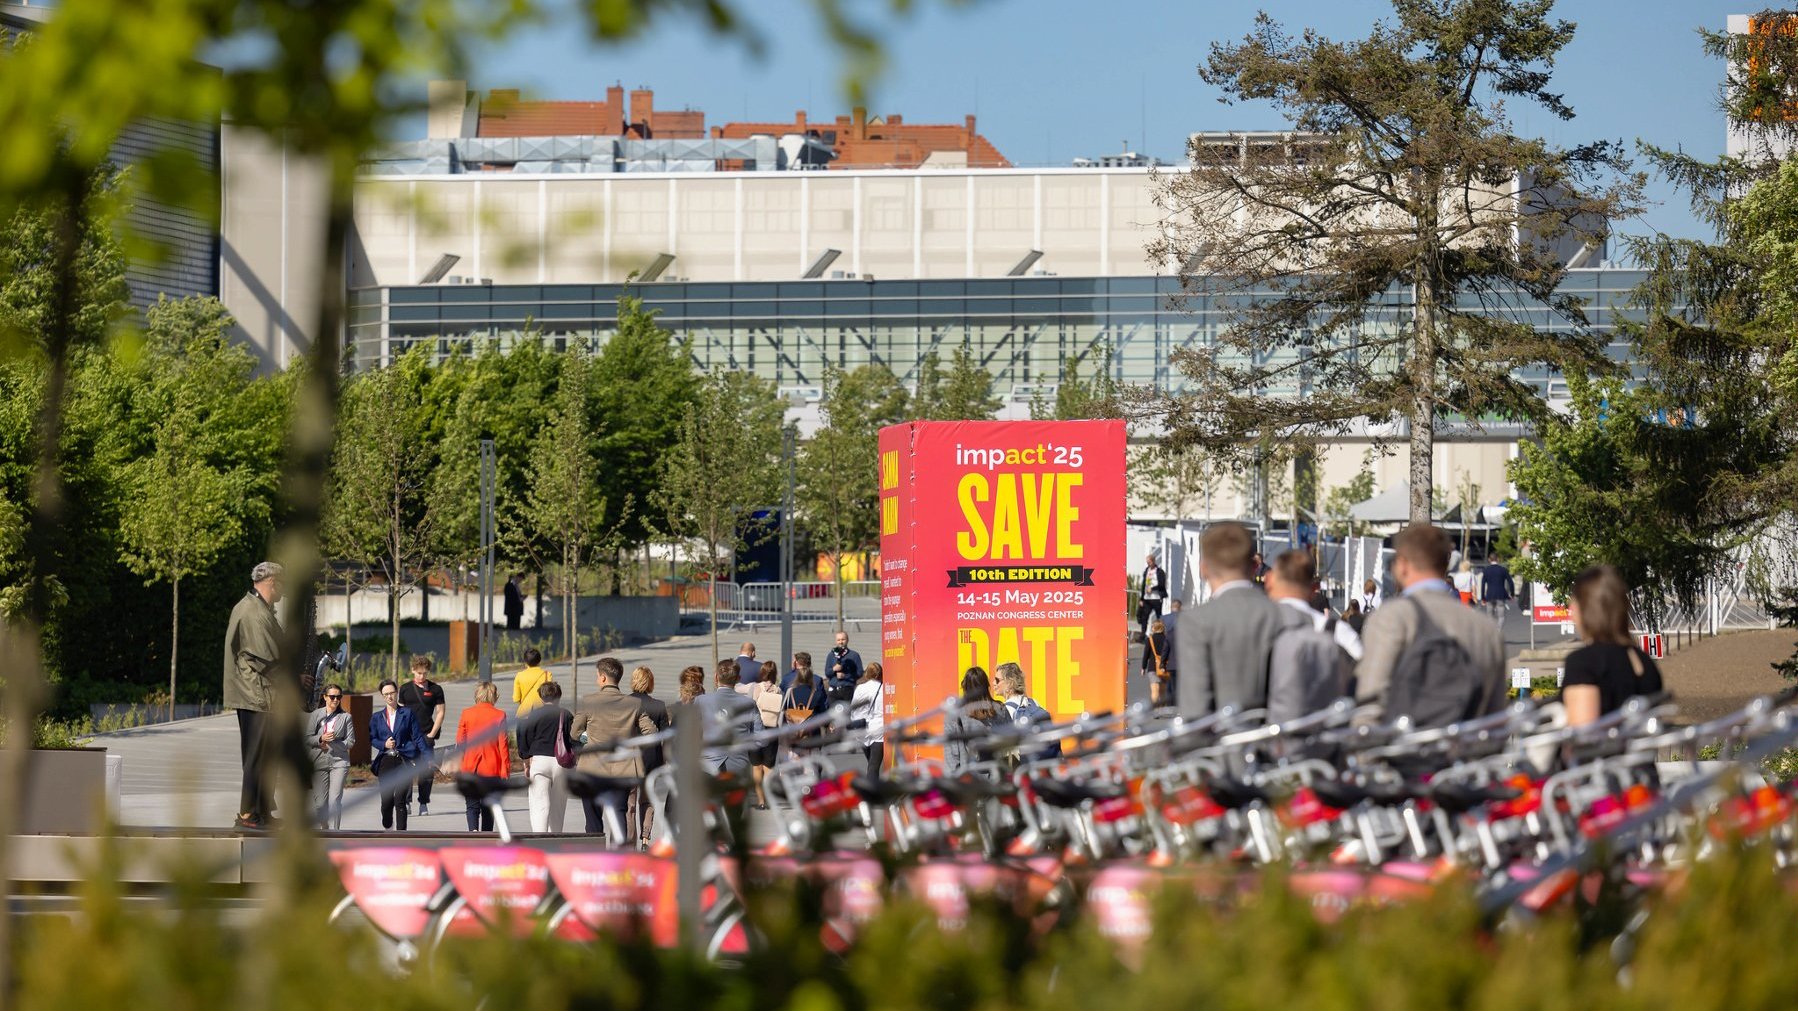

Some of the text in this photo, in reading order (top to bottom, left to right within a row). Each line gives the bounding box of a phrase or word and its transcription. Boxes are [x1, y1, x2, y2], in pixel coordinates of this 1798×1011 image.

[957, 443, 1083, 470] impact‘25
[957, 472, 1083, 560] SAVE
[969, 568, 1072, 580] 10th EDITION
[957, 590, 1083, 607] 14-15 May 2025
[957, 610, 1083, 620] POZNAN CONGRESS CENTER
[960, 630, 972, 643] THE
[1649, 637, 1657, 656] H
